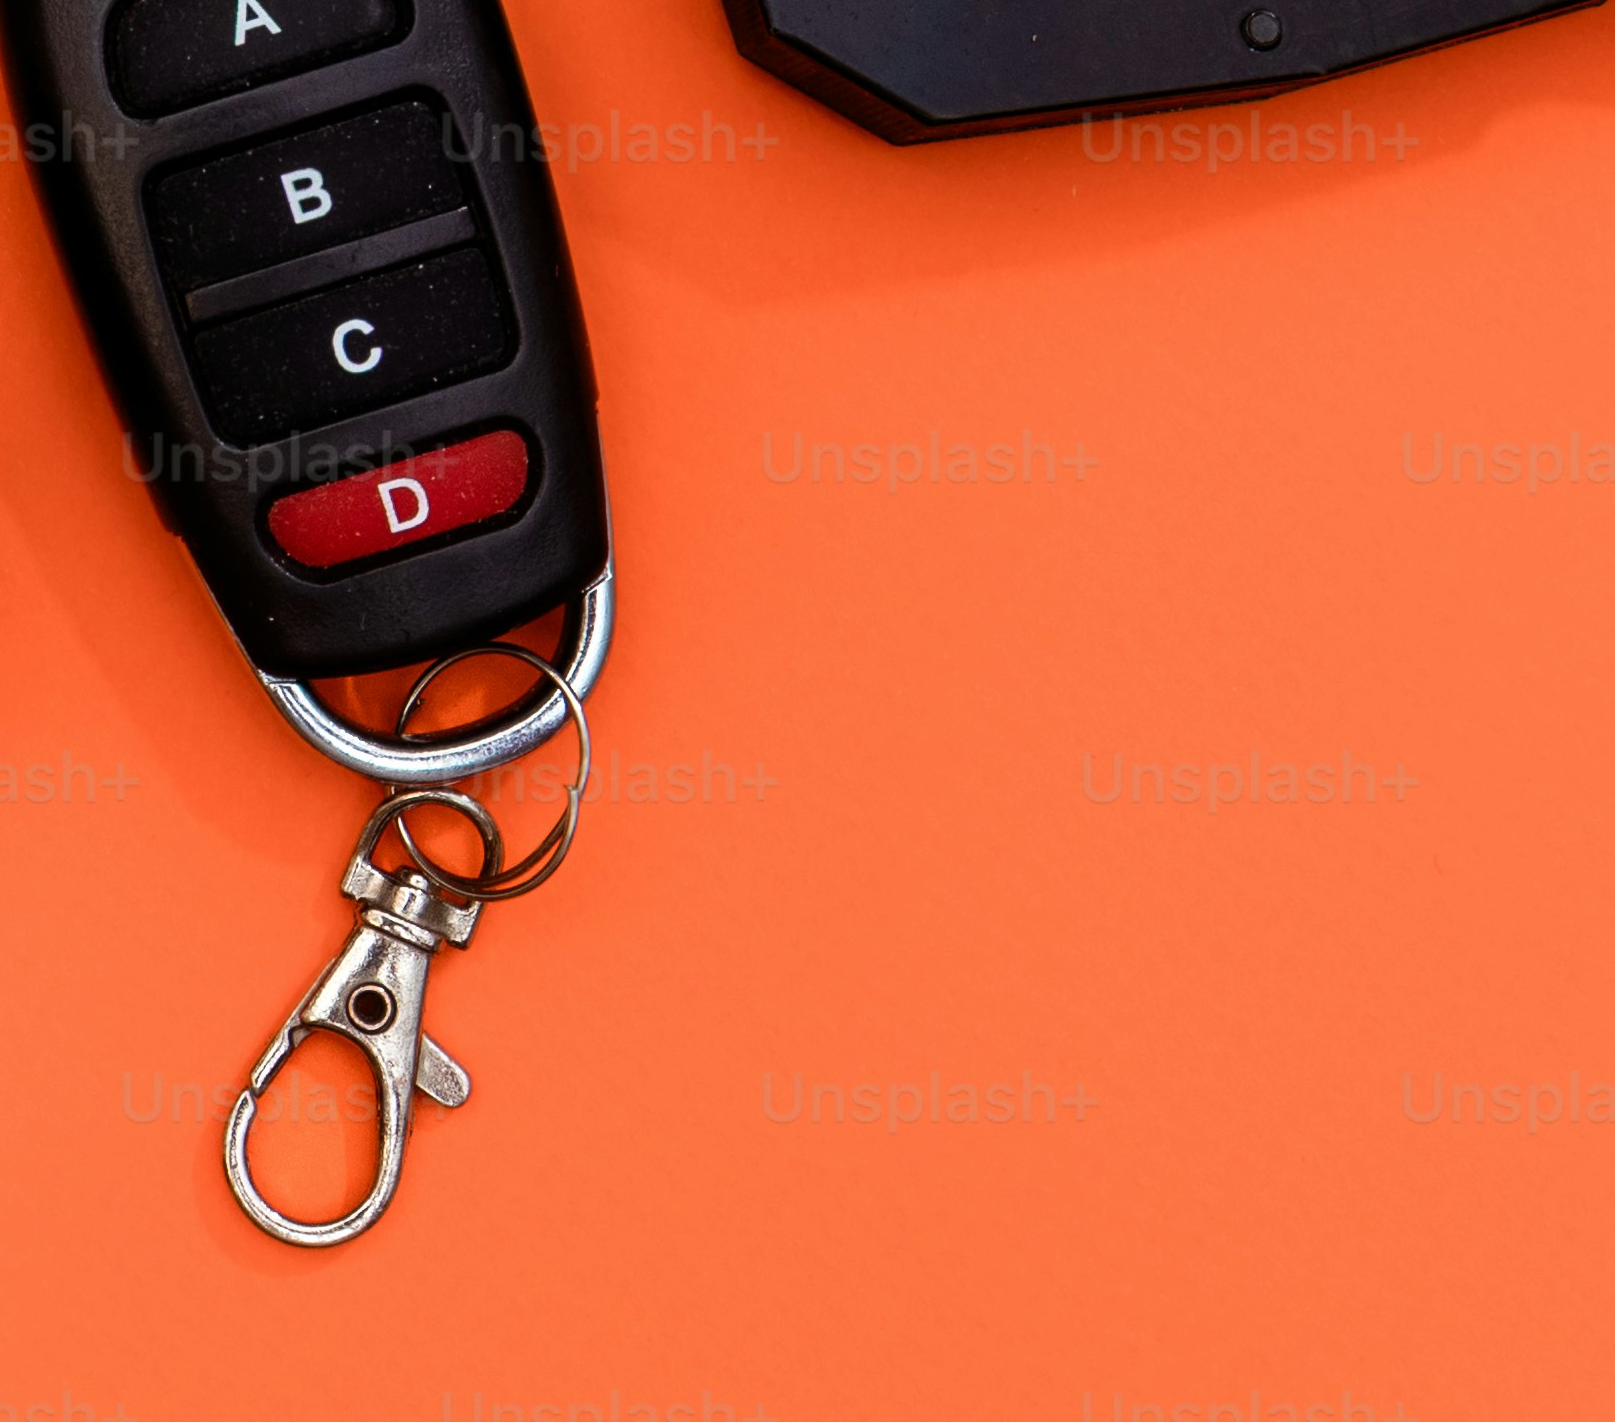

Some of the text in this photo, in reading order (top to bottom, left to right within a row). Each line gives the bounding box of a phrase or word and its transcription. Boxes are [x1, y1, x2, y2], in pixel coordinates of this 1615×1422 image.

[280, 167, 333, 225] B
[331, 319, 383, 374] C
[378, 477, 431, 535] D
